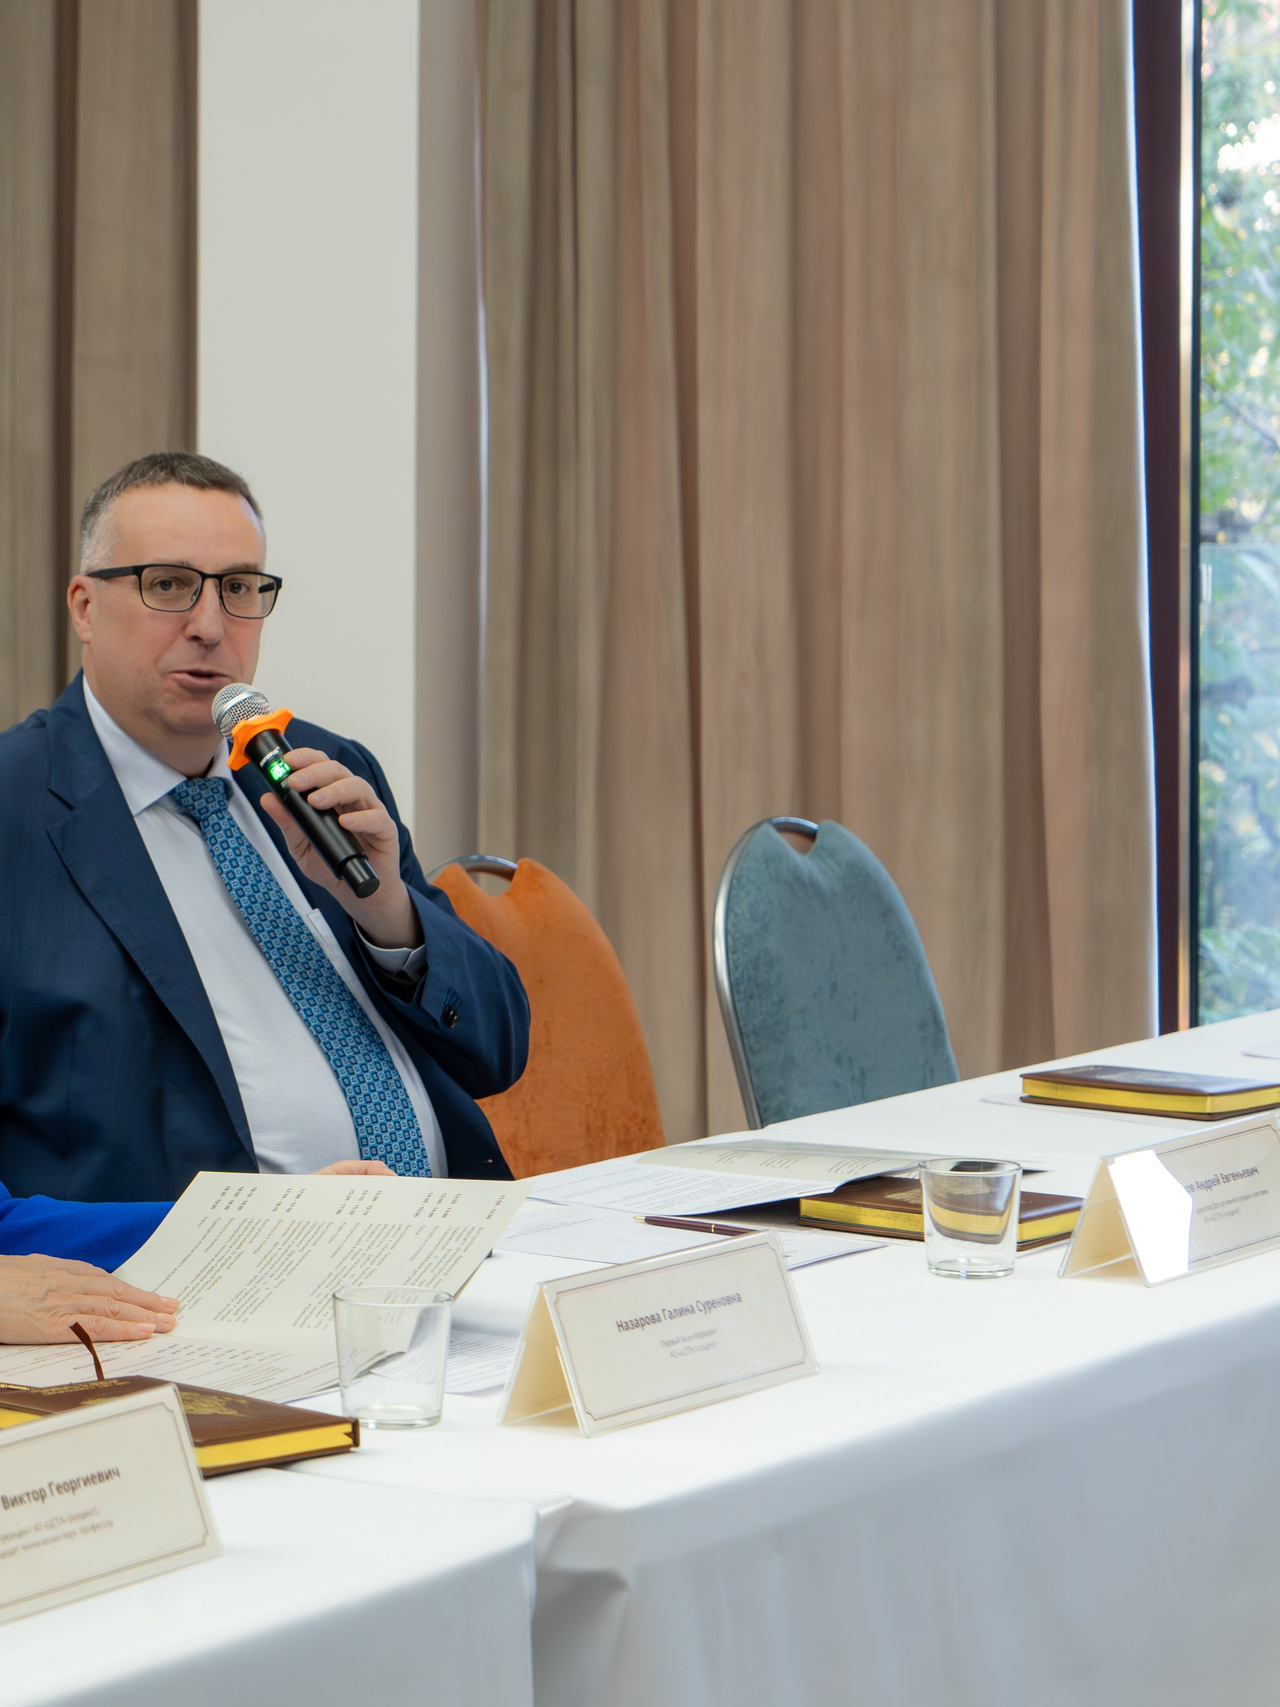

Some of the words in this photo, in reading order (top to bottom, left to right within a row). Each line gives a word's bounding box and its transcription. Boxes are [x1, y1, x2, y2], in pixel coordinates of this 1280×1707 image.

[1194, 1174, 1221, 1192] Андрей
[1221, 1166, 1260, 1184] Евгеньевич
[616, 1312, 662, 1333] Назарова
[662, 1304, 696, 1321] Галина
[696, 1292, 743, 1315] Суреновна
[0, 1486, 47, 1511] Виктор
[48, 1466, 122, 1497] Георгиевич
